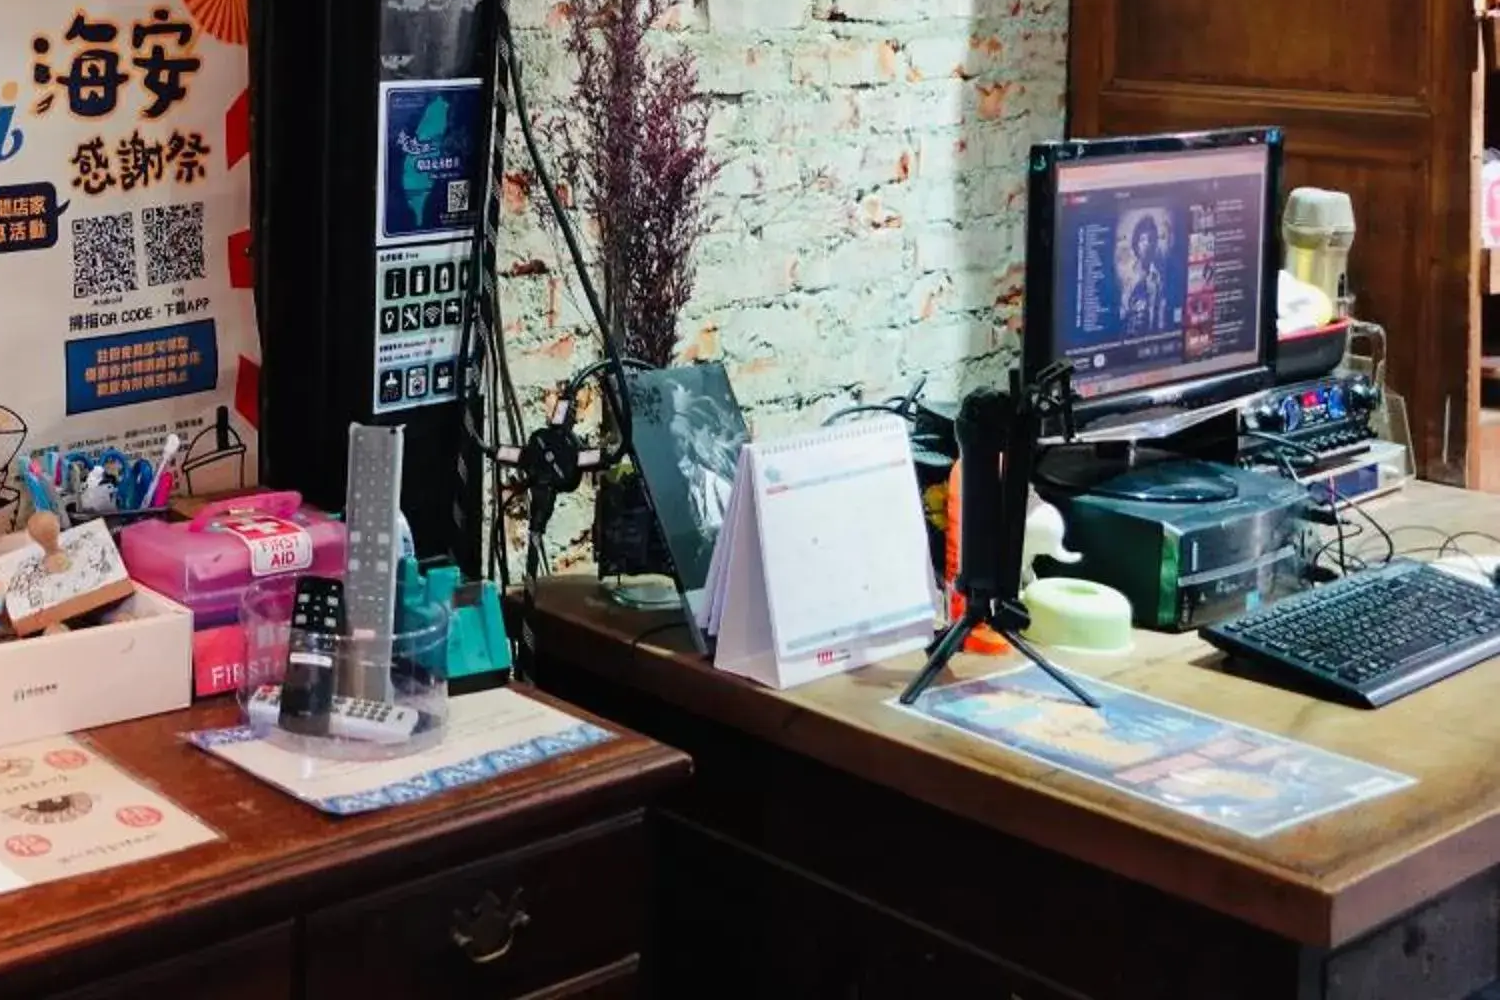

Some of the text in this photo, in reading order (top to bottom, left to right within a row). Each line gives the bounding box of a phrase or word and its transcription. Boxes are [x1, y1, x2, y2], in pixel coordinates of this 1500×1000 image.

[32, 8, 202, 120] 海安
[71, 129, 212, 194] 感謝祭
[261, 536, 300, 553] FIRST
[271, 551, 296, 567] AID
